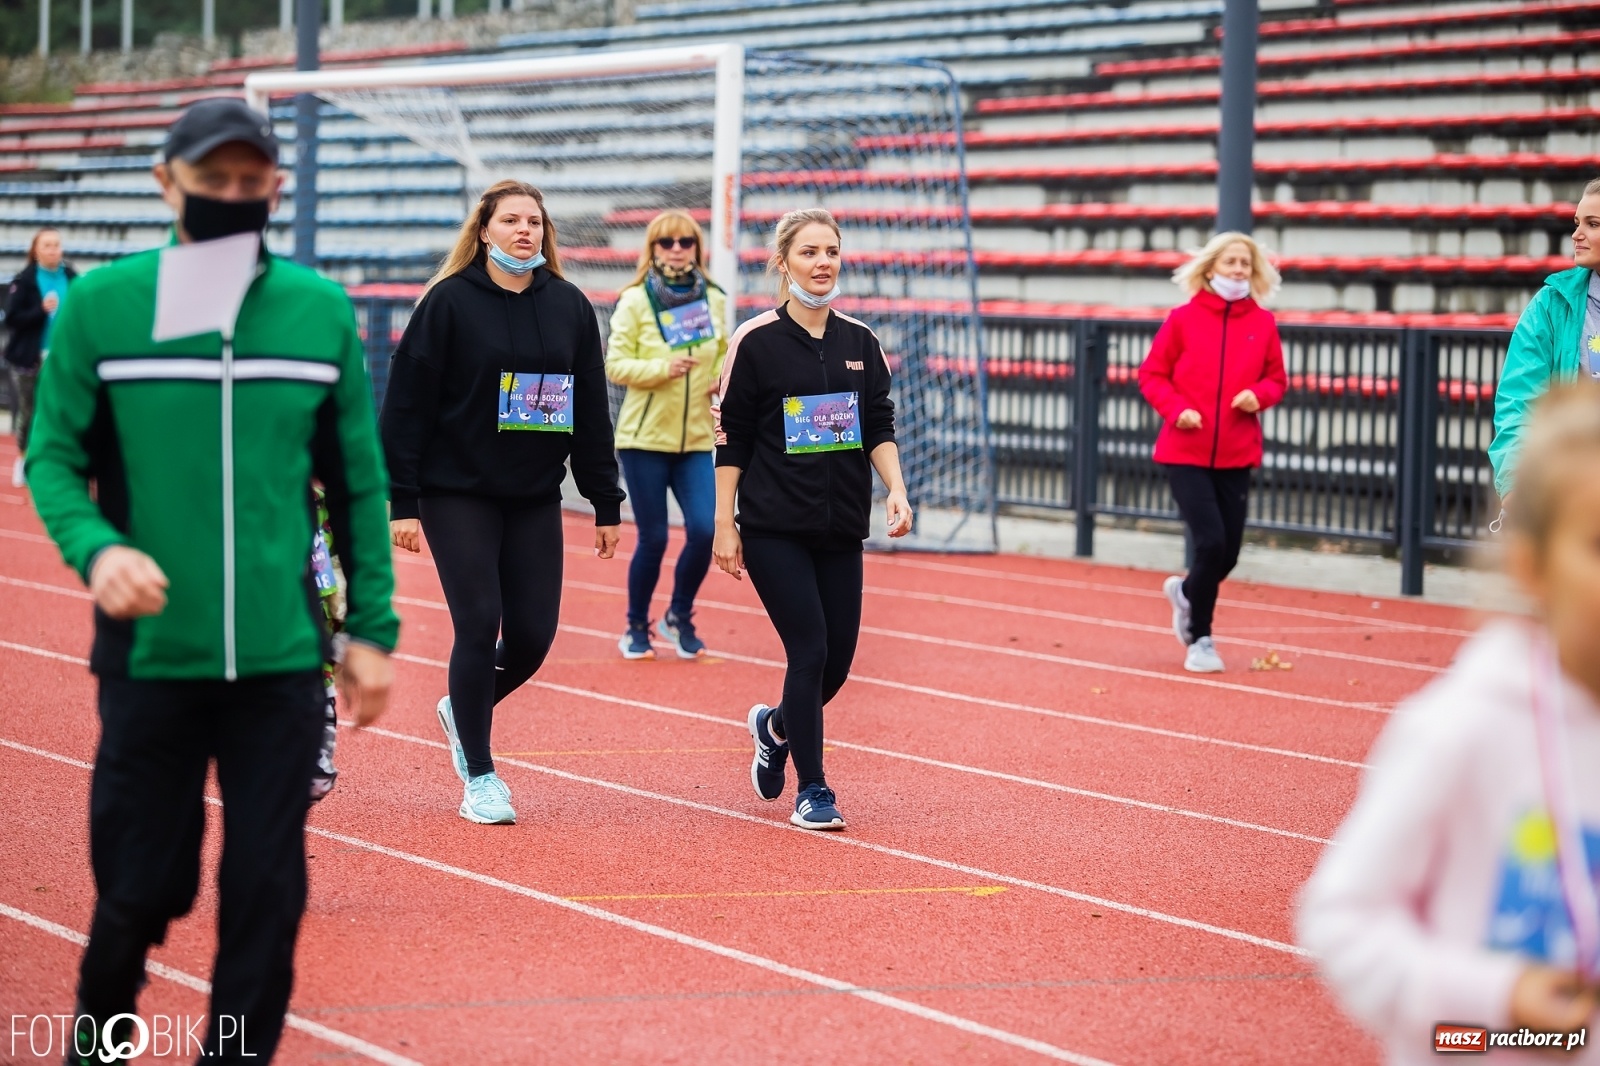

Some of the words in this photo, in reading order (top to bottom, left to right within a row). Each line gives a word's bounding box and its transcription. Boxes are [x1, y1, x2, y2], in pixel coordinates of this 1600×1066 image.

[845, 360, 864, 370] PUM
[542, 413, 566, 424] 300
[795, 415, 811, 424] BIEG
[832, 430, 855, 442] 302
